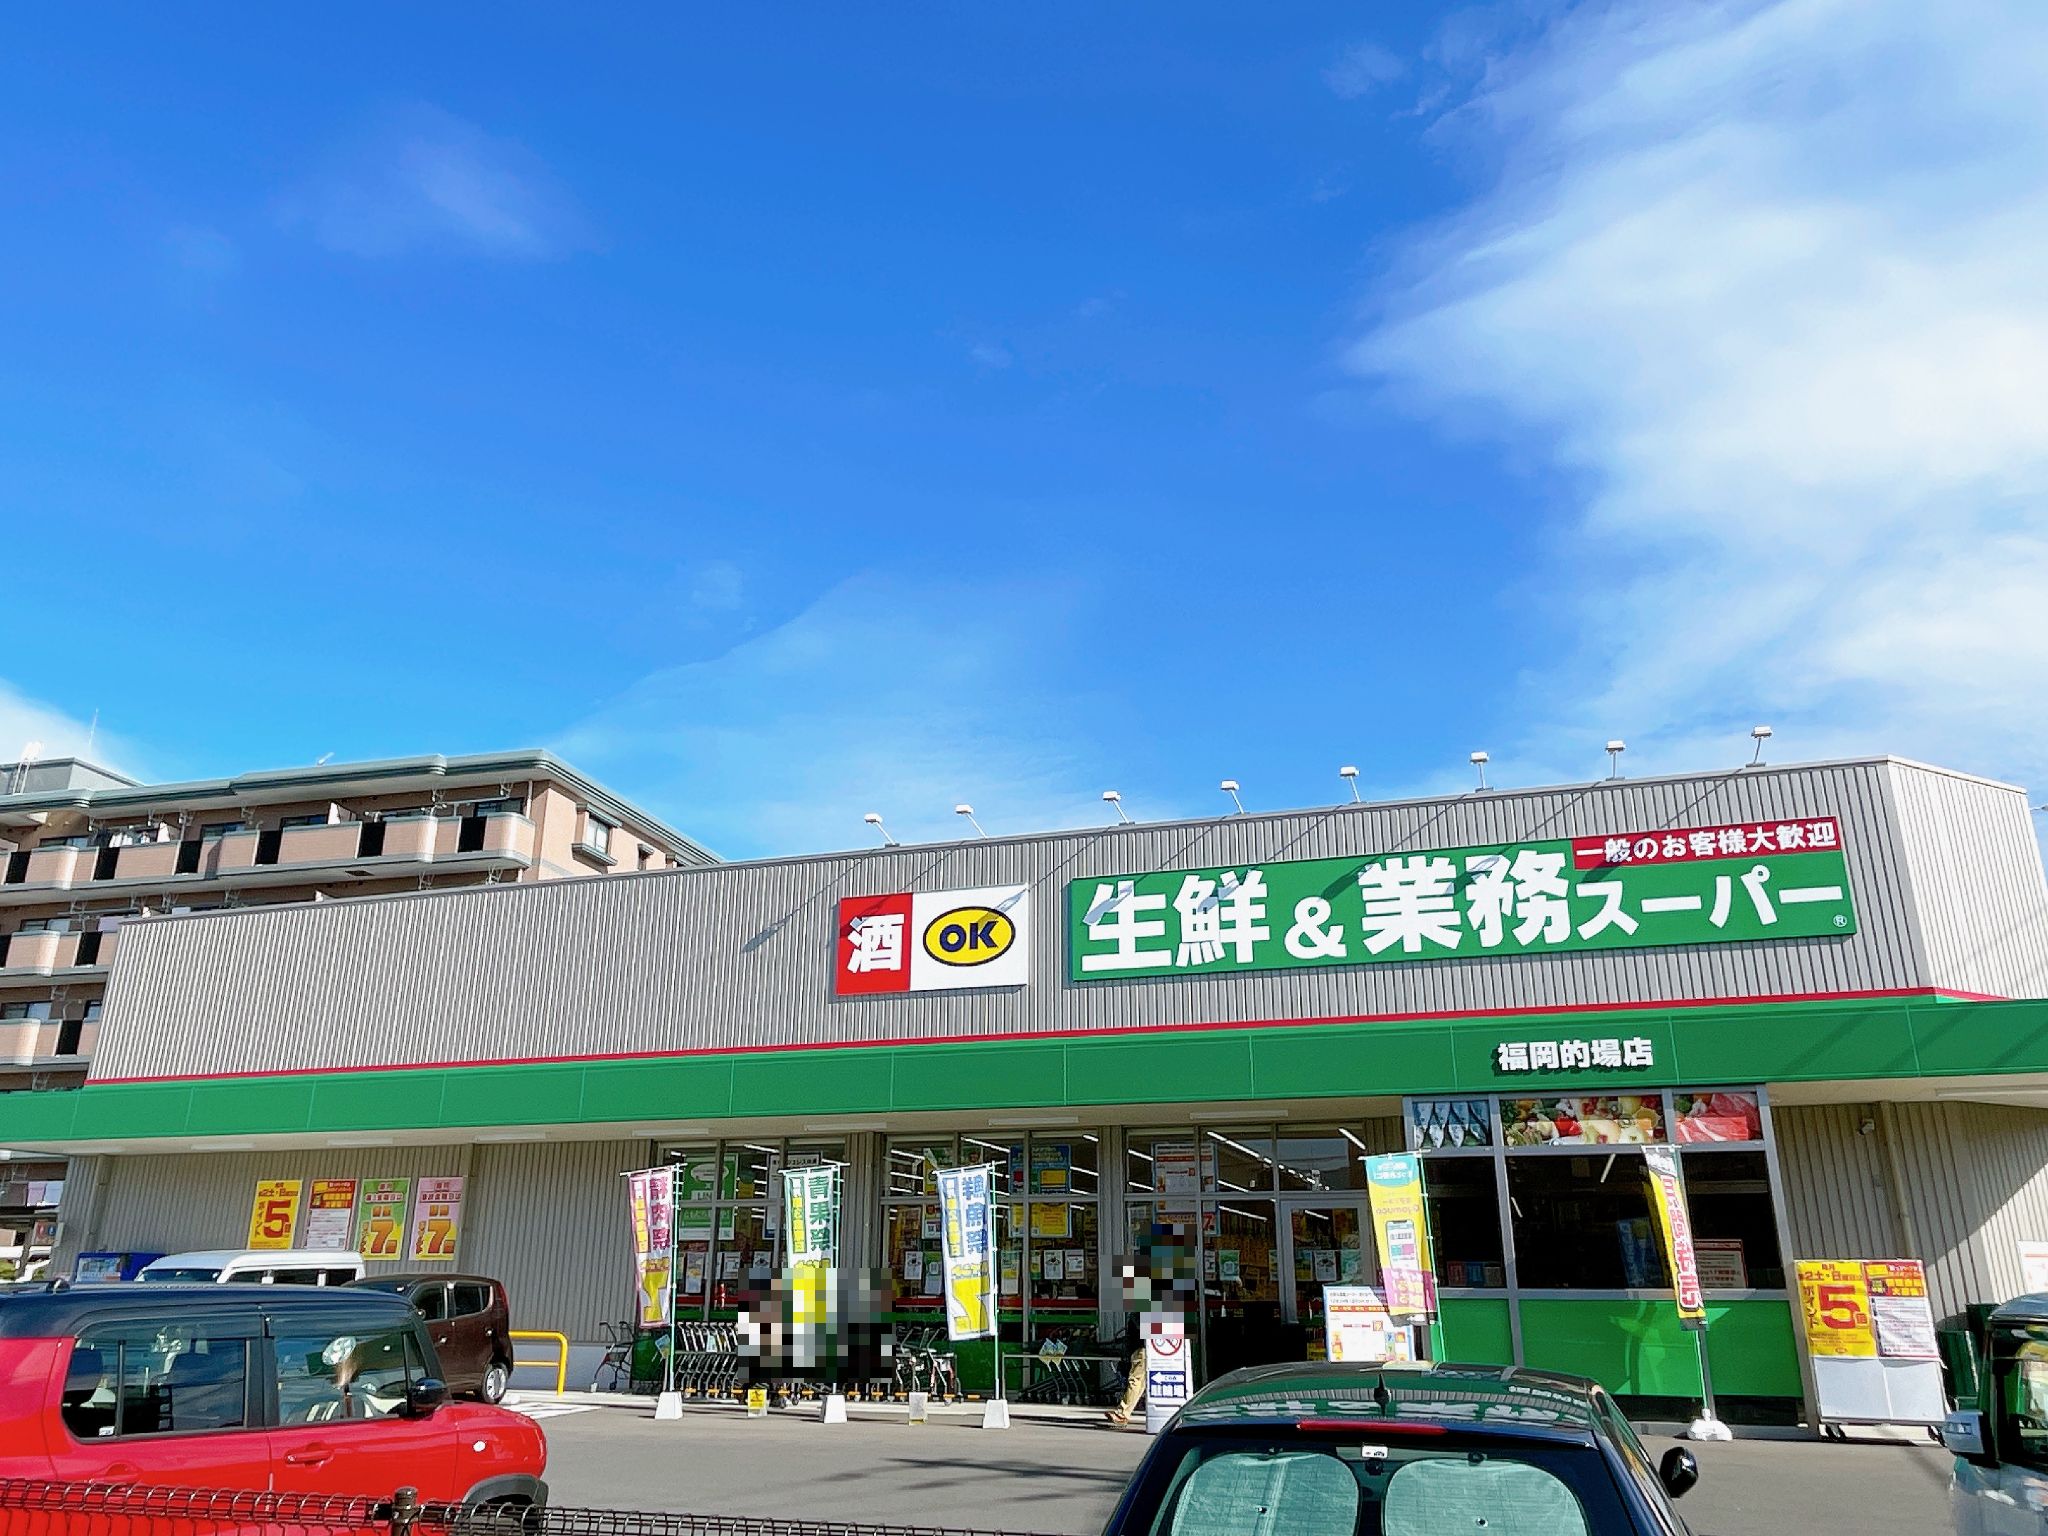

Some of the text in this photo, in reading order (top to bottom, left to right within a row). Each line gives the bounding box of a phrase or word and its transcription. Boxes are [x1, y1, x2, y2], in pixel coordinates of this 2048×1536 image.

[1576, 821, 1836, 864] 一般のお客様大歓迎
[847, 913, 905, 974] 酒
[939, 920, 999, 952] OK
[1497, 1037, 1654, 1072] 福岡的場店
[263, 1200, 291, 1238] 5
[371, 1219, 394, 1254] 7
[428, 1219, 451, 1254] 7
[1803, 1285, 1819, 1329] ポイント
[1819, 1285, 1861, 1329] 5
